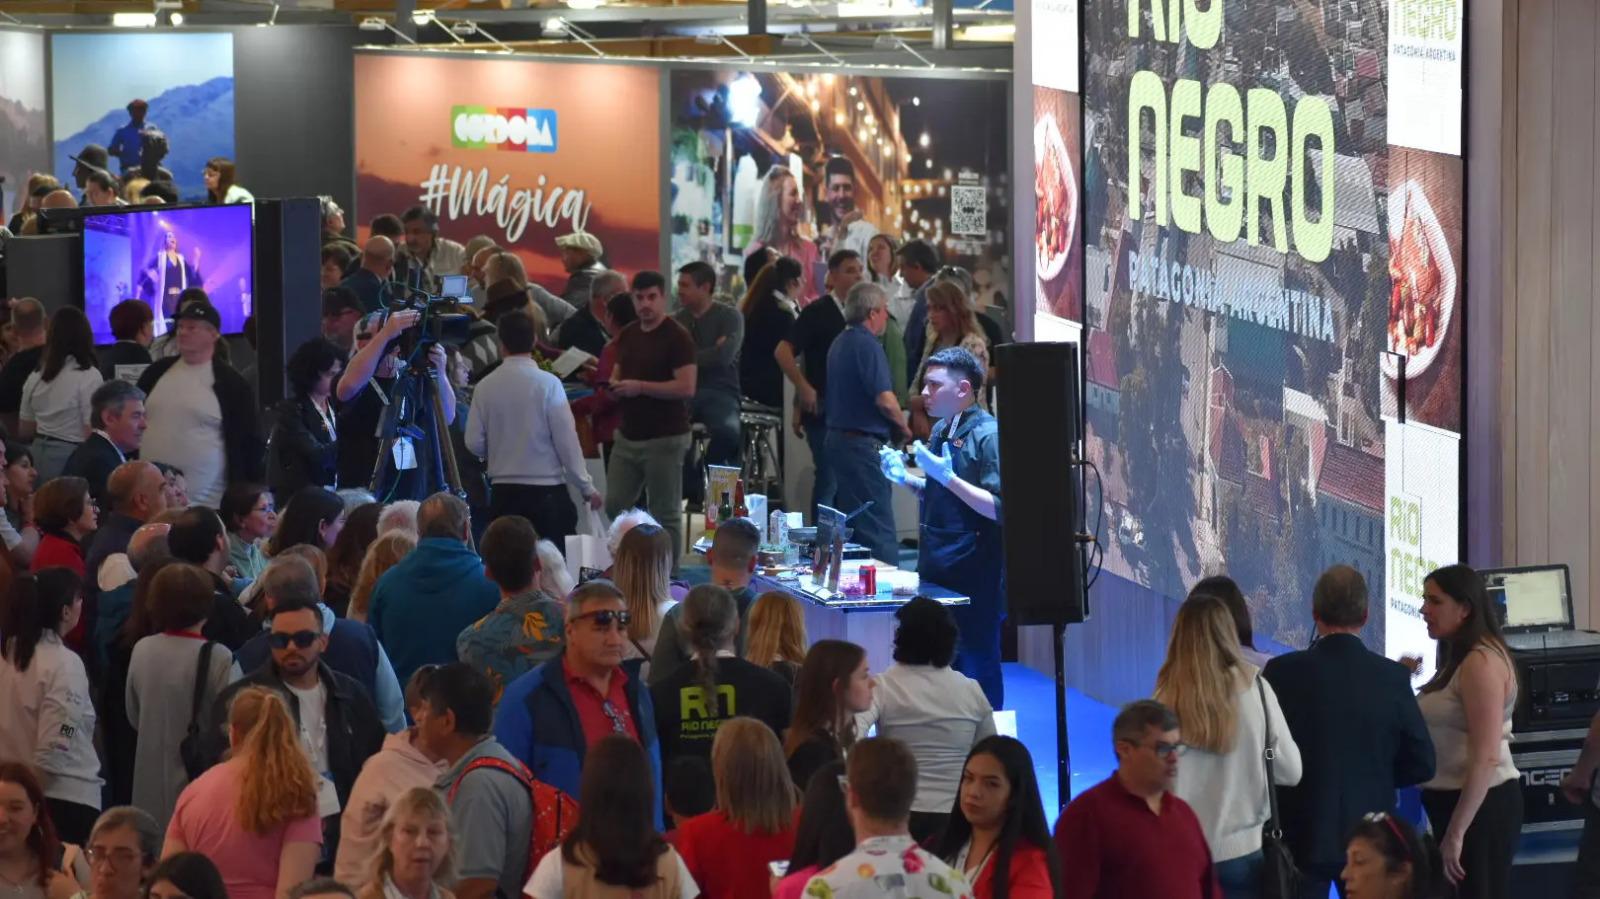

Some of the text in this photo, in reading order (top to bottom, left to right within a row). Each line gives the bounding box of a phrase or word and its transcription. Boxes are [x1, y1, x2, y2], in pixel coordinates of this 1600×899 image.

[1128, 70, 1335, 263] NEGRO
[419, 164, 592, 243] #Mágica
[1129, 250, 1226, 315] PATAGONIA
[1391, 547, 1439, 600] NEG
